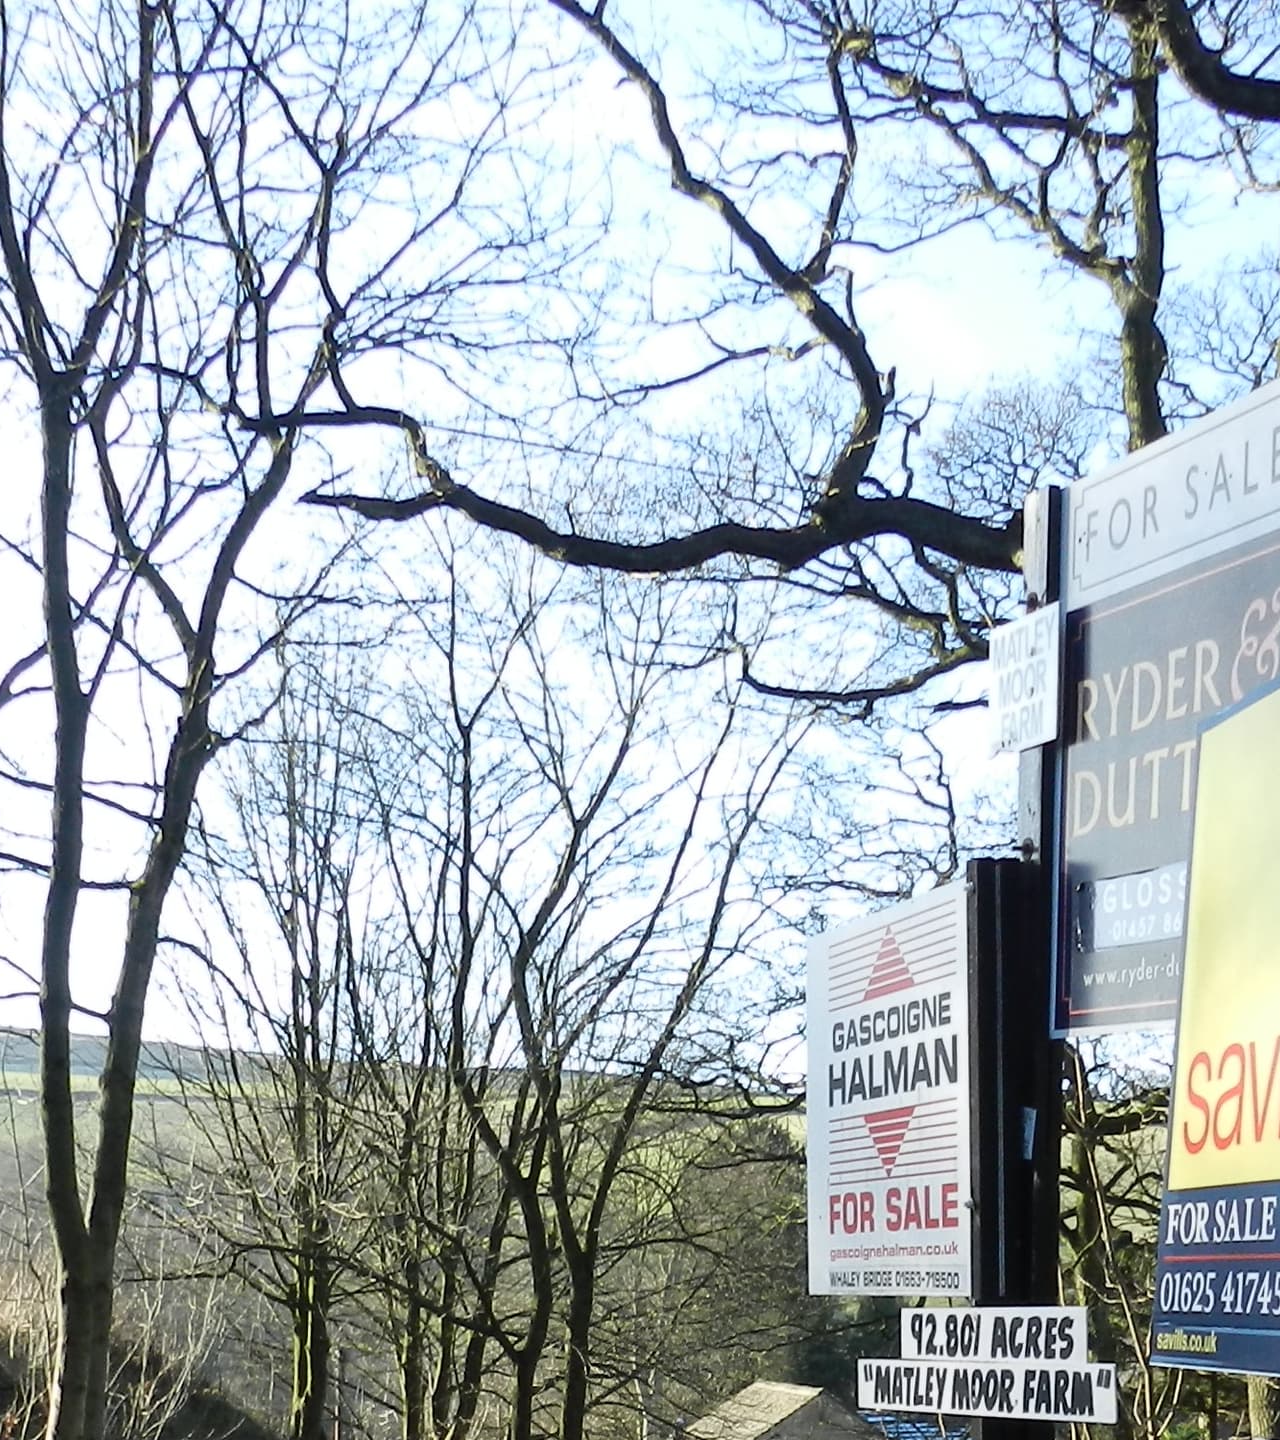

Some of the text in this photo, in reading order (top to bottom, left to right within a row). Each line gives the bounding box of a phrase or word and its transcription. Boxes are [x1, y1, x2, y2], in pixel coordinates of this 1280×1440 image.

[1085, 485, 1160, 562] FOR
[993, 611, 1056, 672] MATLEY
[999, 658, 1048, 708] MOOR
[1077, 640, 1221, 741] RYDER
[1001, 701, 1044, 744] FARM
[832, 991, 952, 1053] GASCOIGNE
[828, 1034, 959, 1107] HALMAN
[828, 1182, 960, 1236] FOR SALE
[1164, 1195, 1278, 1245] FOR SALE
[829, 1241, 960, 1262] gascoignehalman.co.uk
[828, 1270, 861, 1288] WHALEY
[862, 1270, 893, 1288] BRIDGE
[1159, 1271, 1217, 1313] 01625
[990, 1315, 1075, 1360] ACRES
[1156, 1328, 1218, 1354] savills.co.uk
[863, 1362, 1112, 1417] "MATLEY MOOR FARM"
